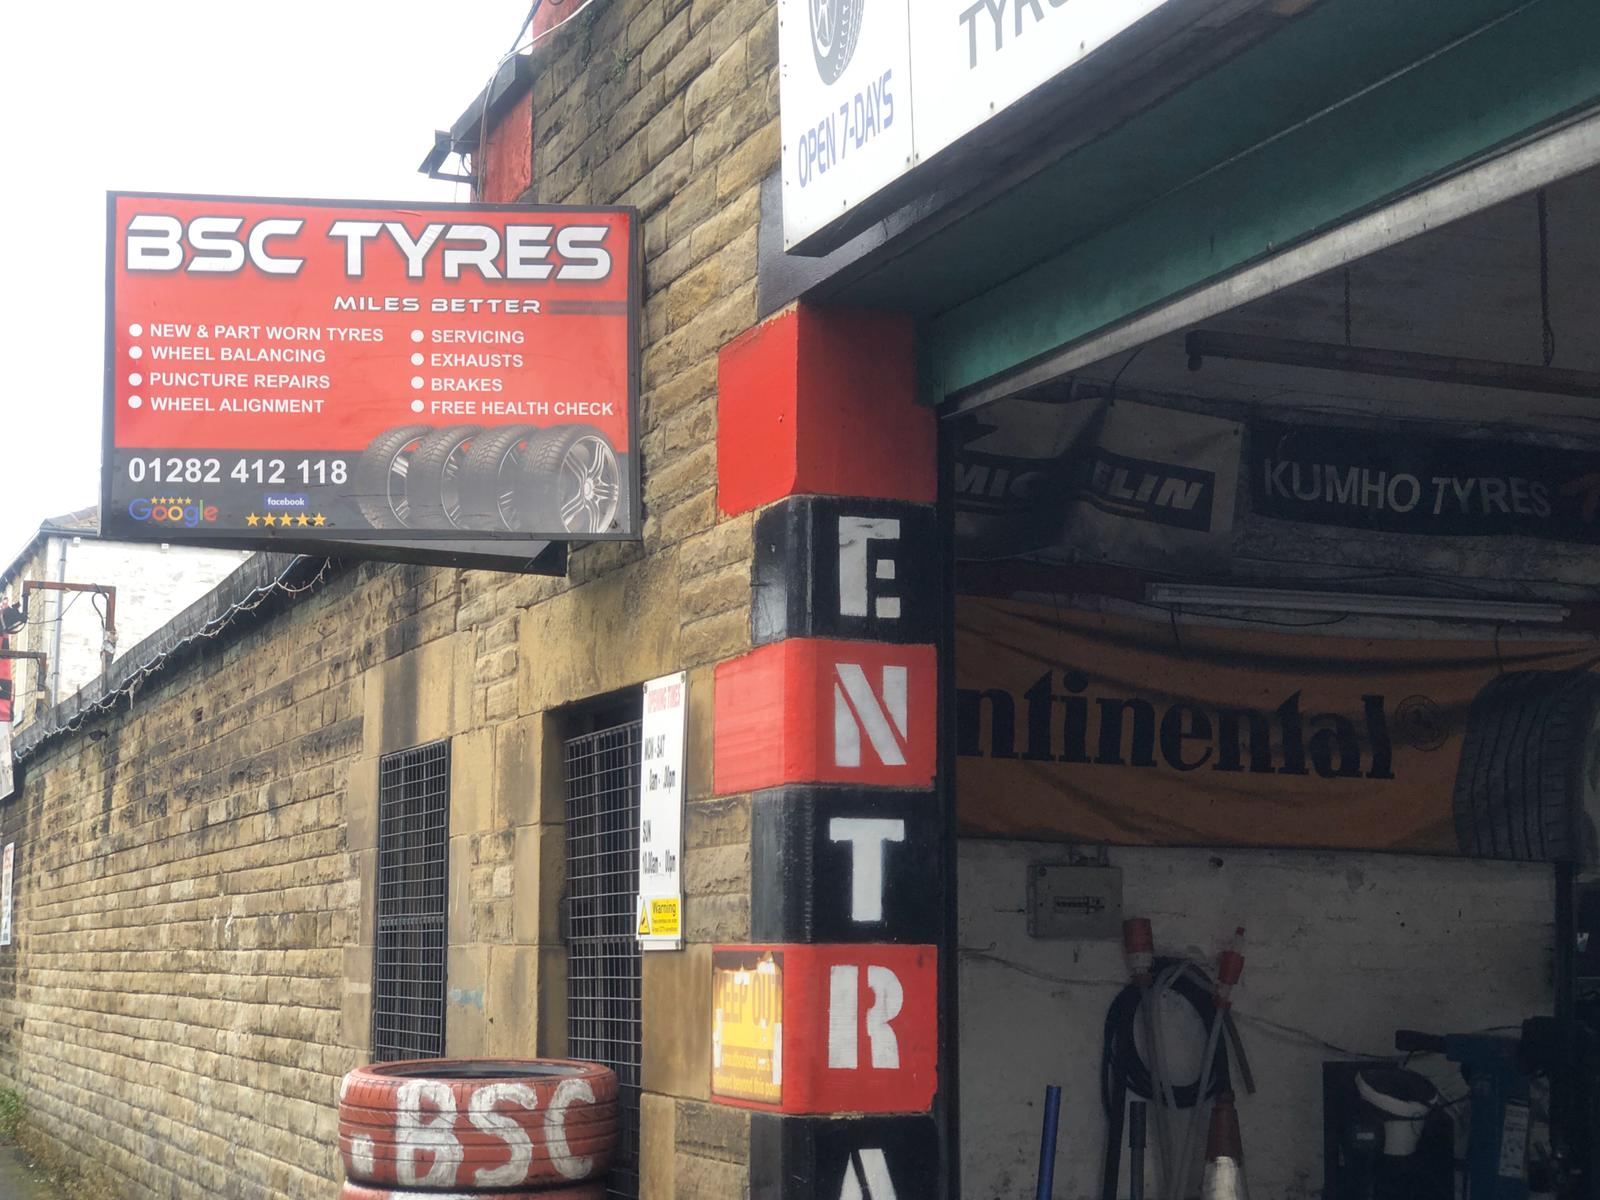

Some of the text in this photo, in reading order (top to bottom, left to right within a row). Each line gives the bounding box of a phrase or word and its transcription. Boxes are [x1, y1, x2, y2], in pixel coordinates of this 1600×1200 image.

[959, 0, 1069, 69] TYR
[798, 68, 894, 188] OPEN 7-DAYS
[126, 215, 611, 281] BSC TYRES
[333, 296, 541, 314] MILES BETTER
[150, 323, 384, 343] NEW & PART WORN TYRES
[431, 329, 524, 345] SERVICING
[150, 345, 326, 363] WHEEL BALANCING
[431, 353, 523, 368] EXHAUSTS
[150, 372, 330, 390] PUNCTURE REPAIRS
[431, 377, 503, 392] BRAKES
[150, 396, 325, 414] WHEEL ALIGNMENT
[431, 400, 613, 416] FREE HEALTH CHECK
[128, 457, 348, 485] 01282 412 118
[954, 459, 1206, 510] MICELIN
[1263, 457, 1552, 518] KUMHO TYRES
[267, 496, 305, 507] facebook
[128, 498, 219, 528] Google
[643, 820, 651, 843] SUN
[652, 902, 676, 917] Warning
[395, 1078, 597, 1188] BSC
